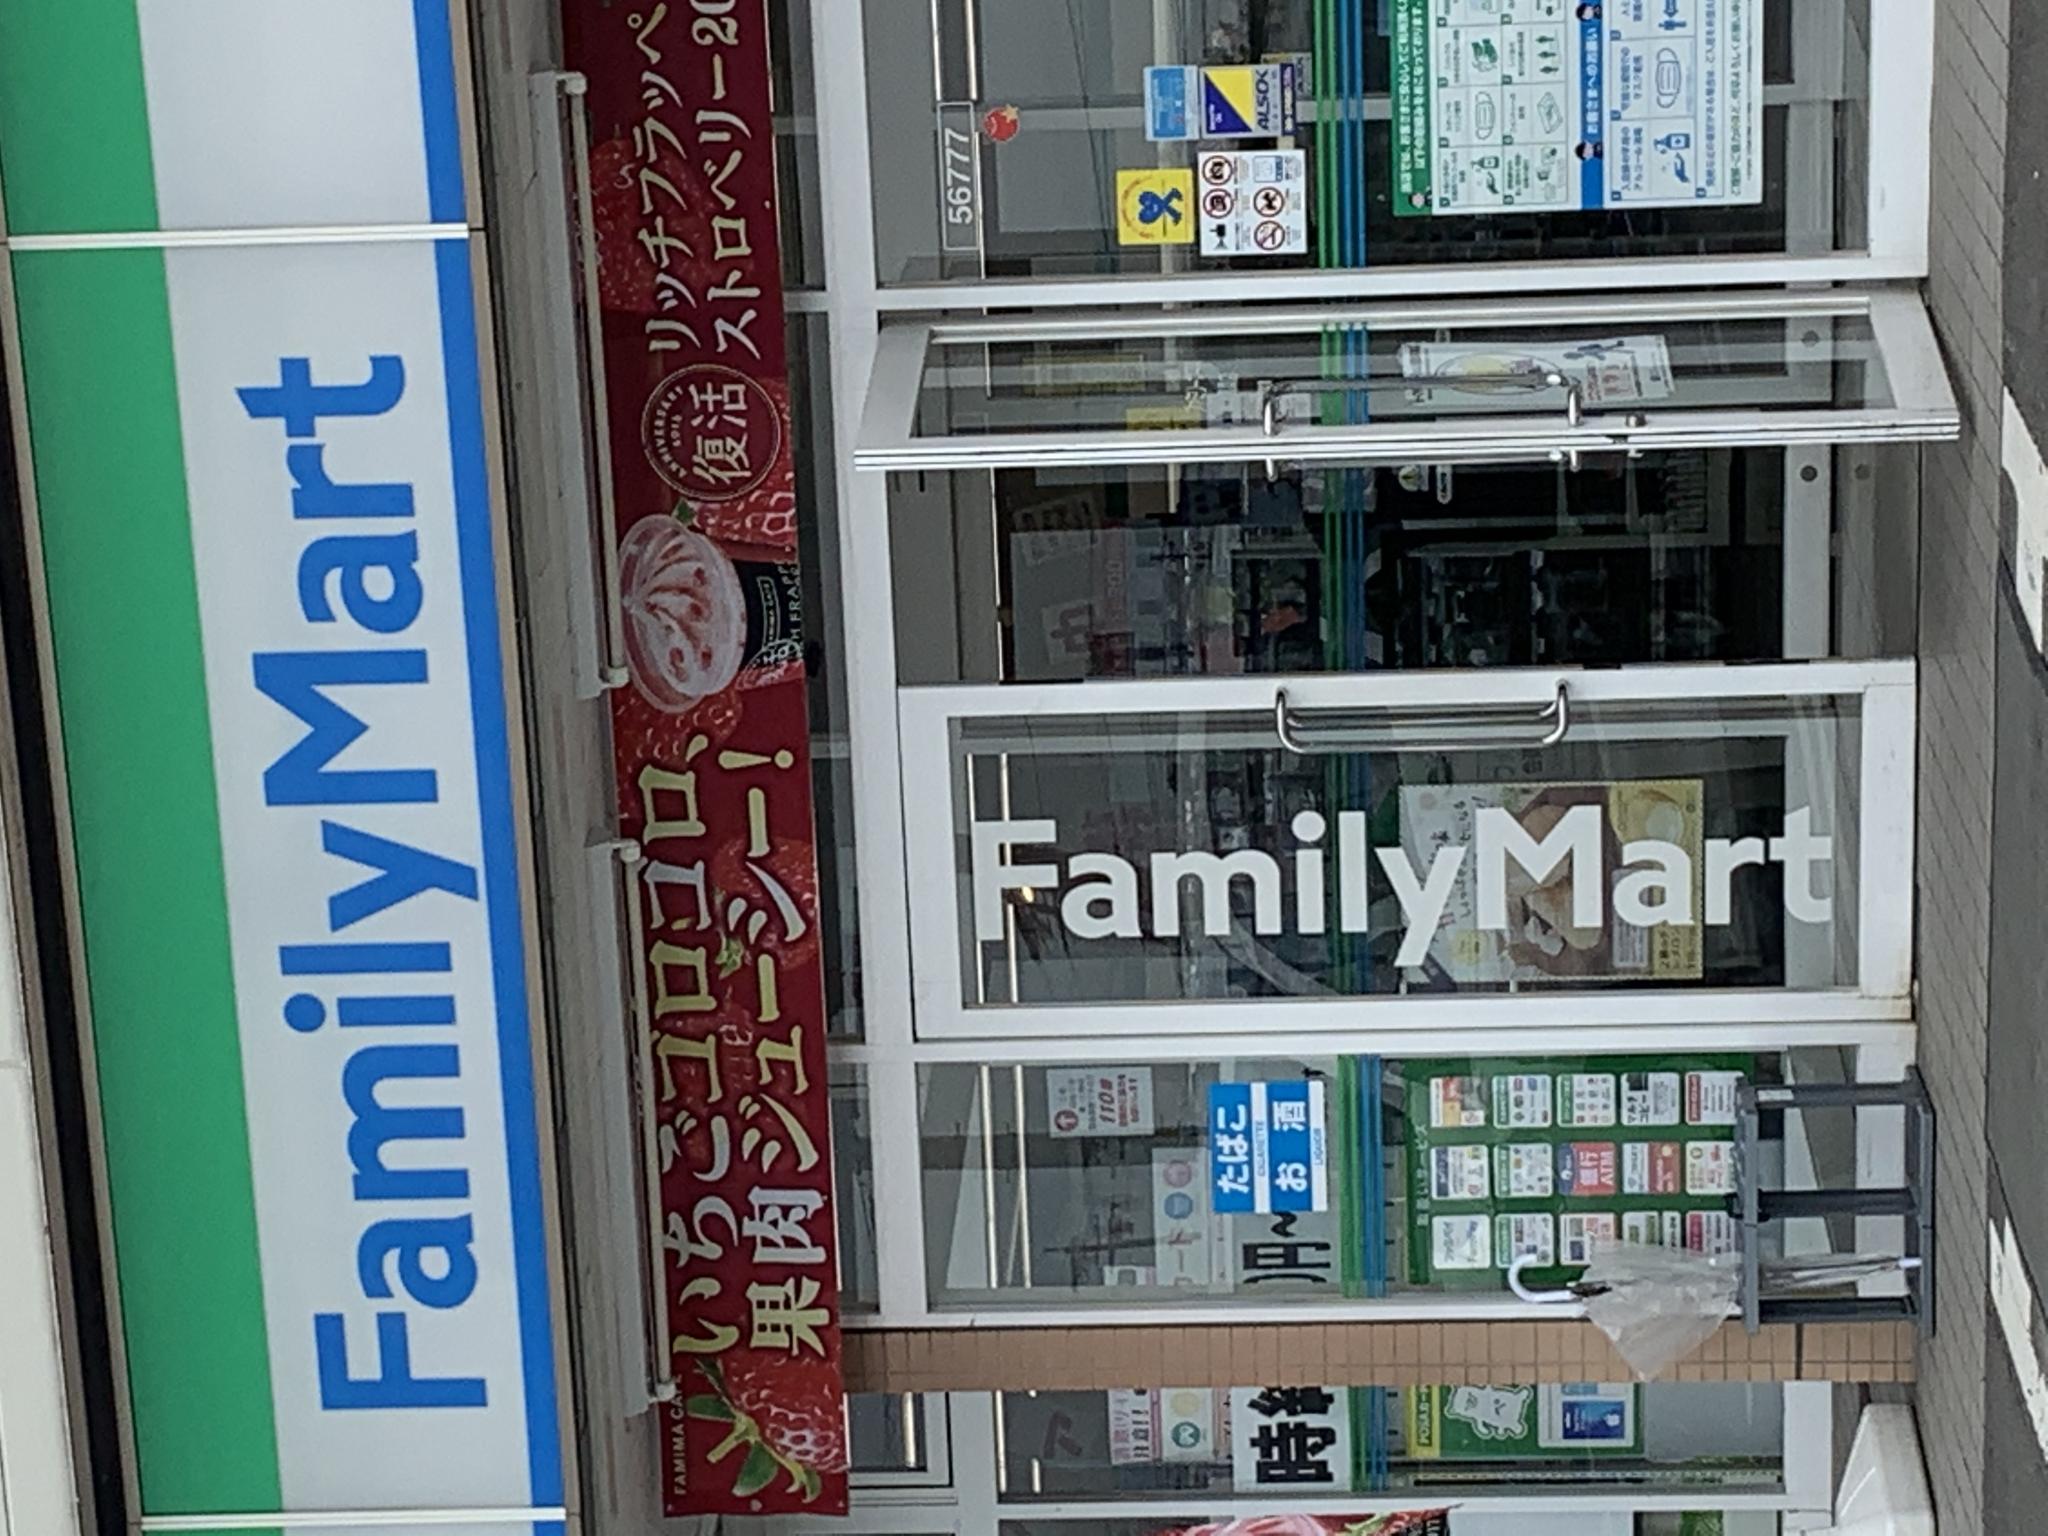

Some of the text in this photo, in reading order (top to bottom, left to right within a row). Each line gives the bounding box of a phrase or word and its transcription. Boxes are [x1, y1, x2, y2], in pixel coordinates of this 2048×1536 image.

[1255, 69, 1269, 131] ALSOK
[627, 3, 701, 352] リッチフラッペ
[944, 127, 974, 225] 56777
[688, 382, 752, 484] 復活
[236, 354, 487, 1410] FamilyMart
[971, 805, 1832, 966] FamilyMart
[1216, 1104, 1249, 1194] たばこ
[1579, 1151, 1599, 1186] 銀行
[1600, 1151, 1614, 1185] ATM
[671, 1423, 687, 1496] FAMIMA
